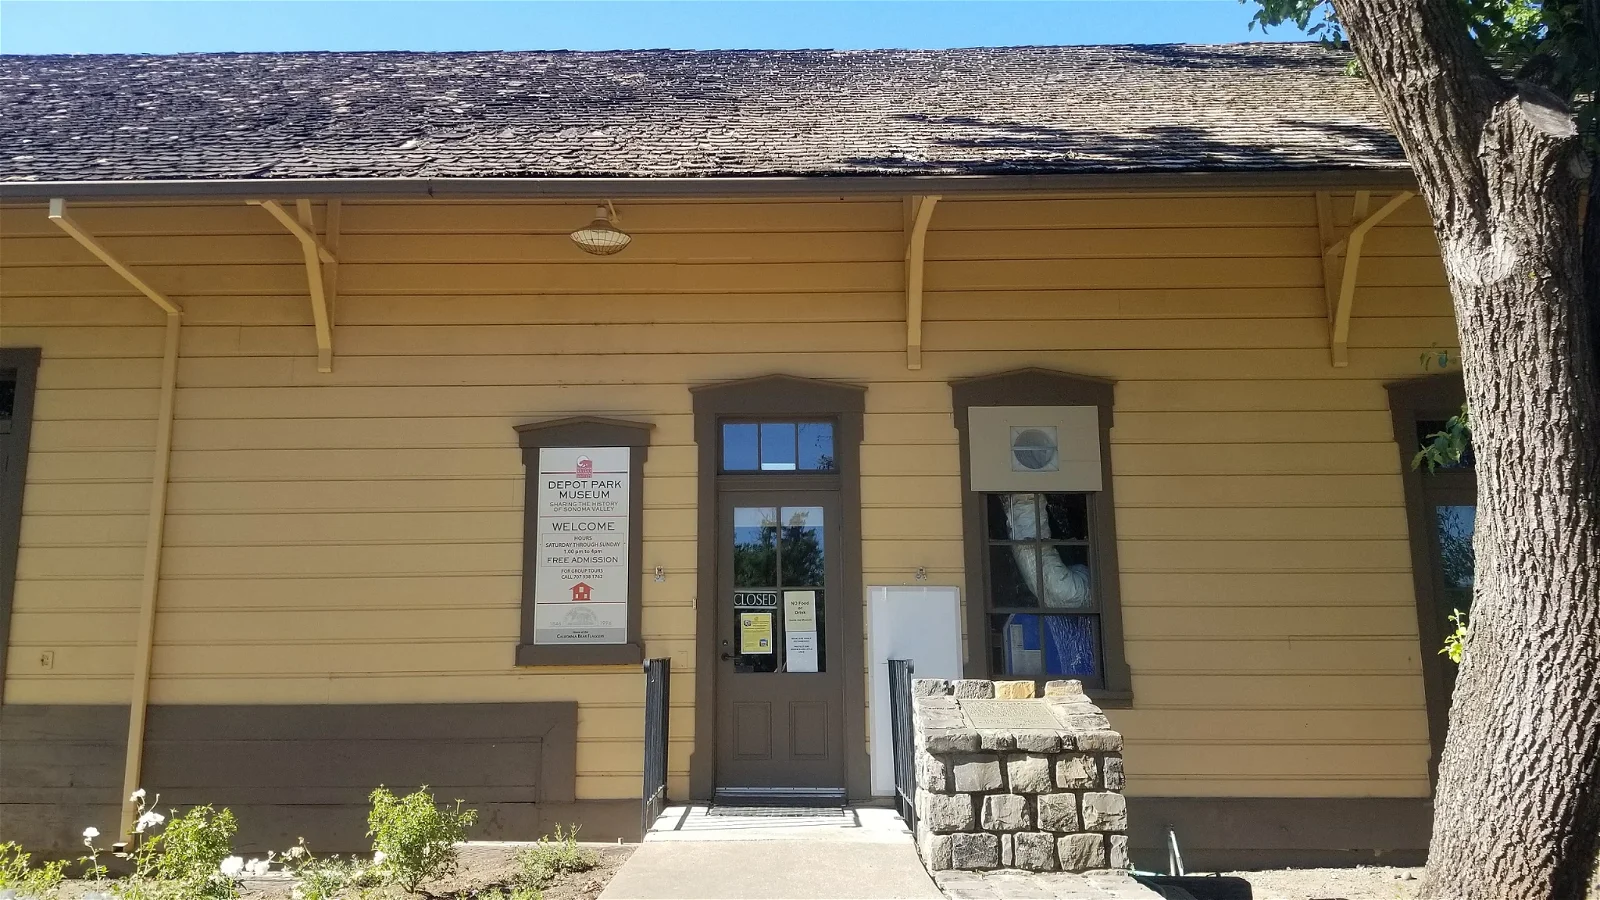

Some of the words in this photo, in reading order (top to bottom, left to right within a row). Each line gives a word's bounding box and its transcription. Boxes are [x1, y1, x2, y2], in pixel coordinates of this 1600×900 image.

[548, 481, 588, 489] DEPOT
[591, 480, 622, 489] PARK
[559, 491, 610, 499] MUSEUM
[552, 522, 615, 531] WELCOME
[571, 556, 619, 564] ADMISSION
[734, 593, 777, 606] CLOSED
